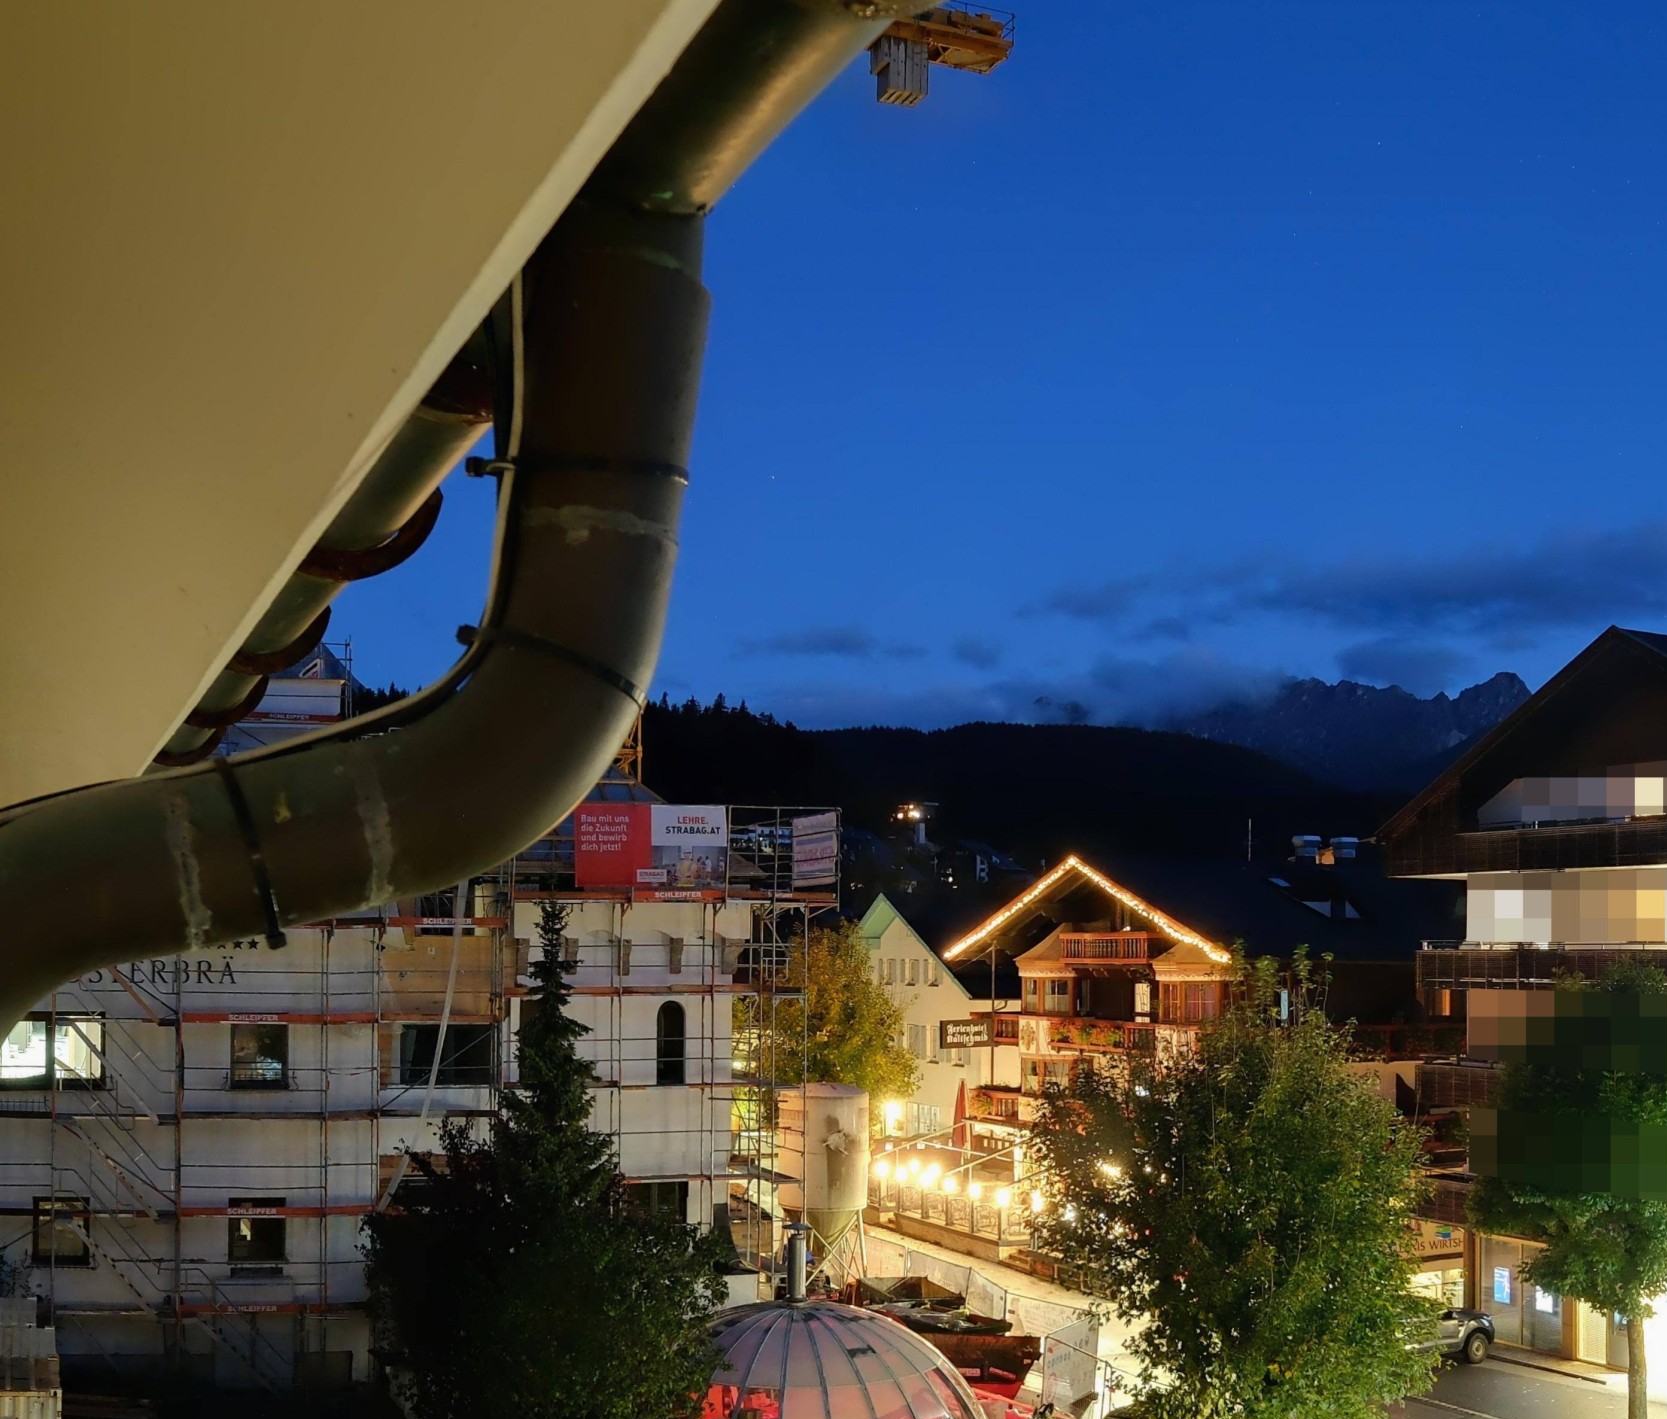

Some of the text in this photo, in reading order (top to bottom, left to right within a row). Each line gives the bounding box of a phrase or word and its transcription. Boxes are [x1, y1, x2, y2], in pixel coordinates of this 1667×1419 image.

[581, 814, 630, 823] Bau mit uns
[677, 816, 709, 825] LEHRE.
[581, 824, 628, 832] die Zukunft
[665, 826, 721, 835] STRABAG.AT
[581, 833, 628, 841] und bewirb
[581, 843, 621, 853] dich jetzt!
